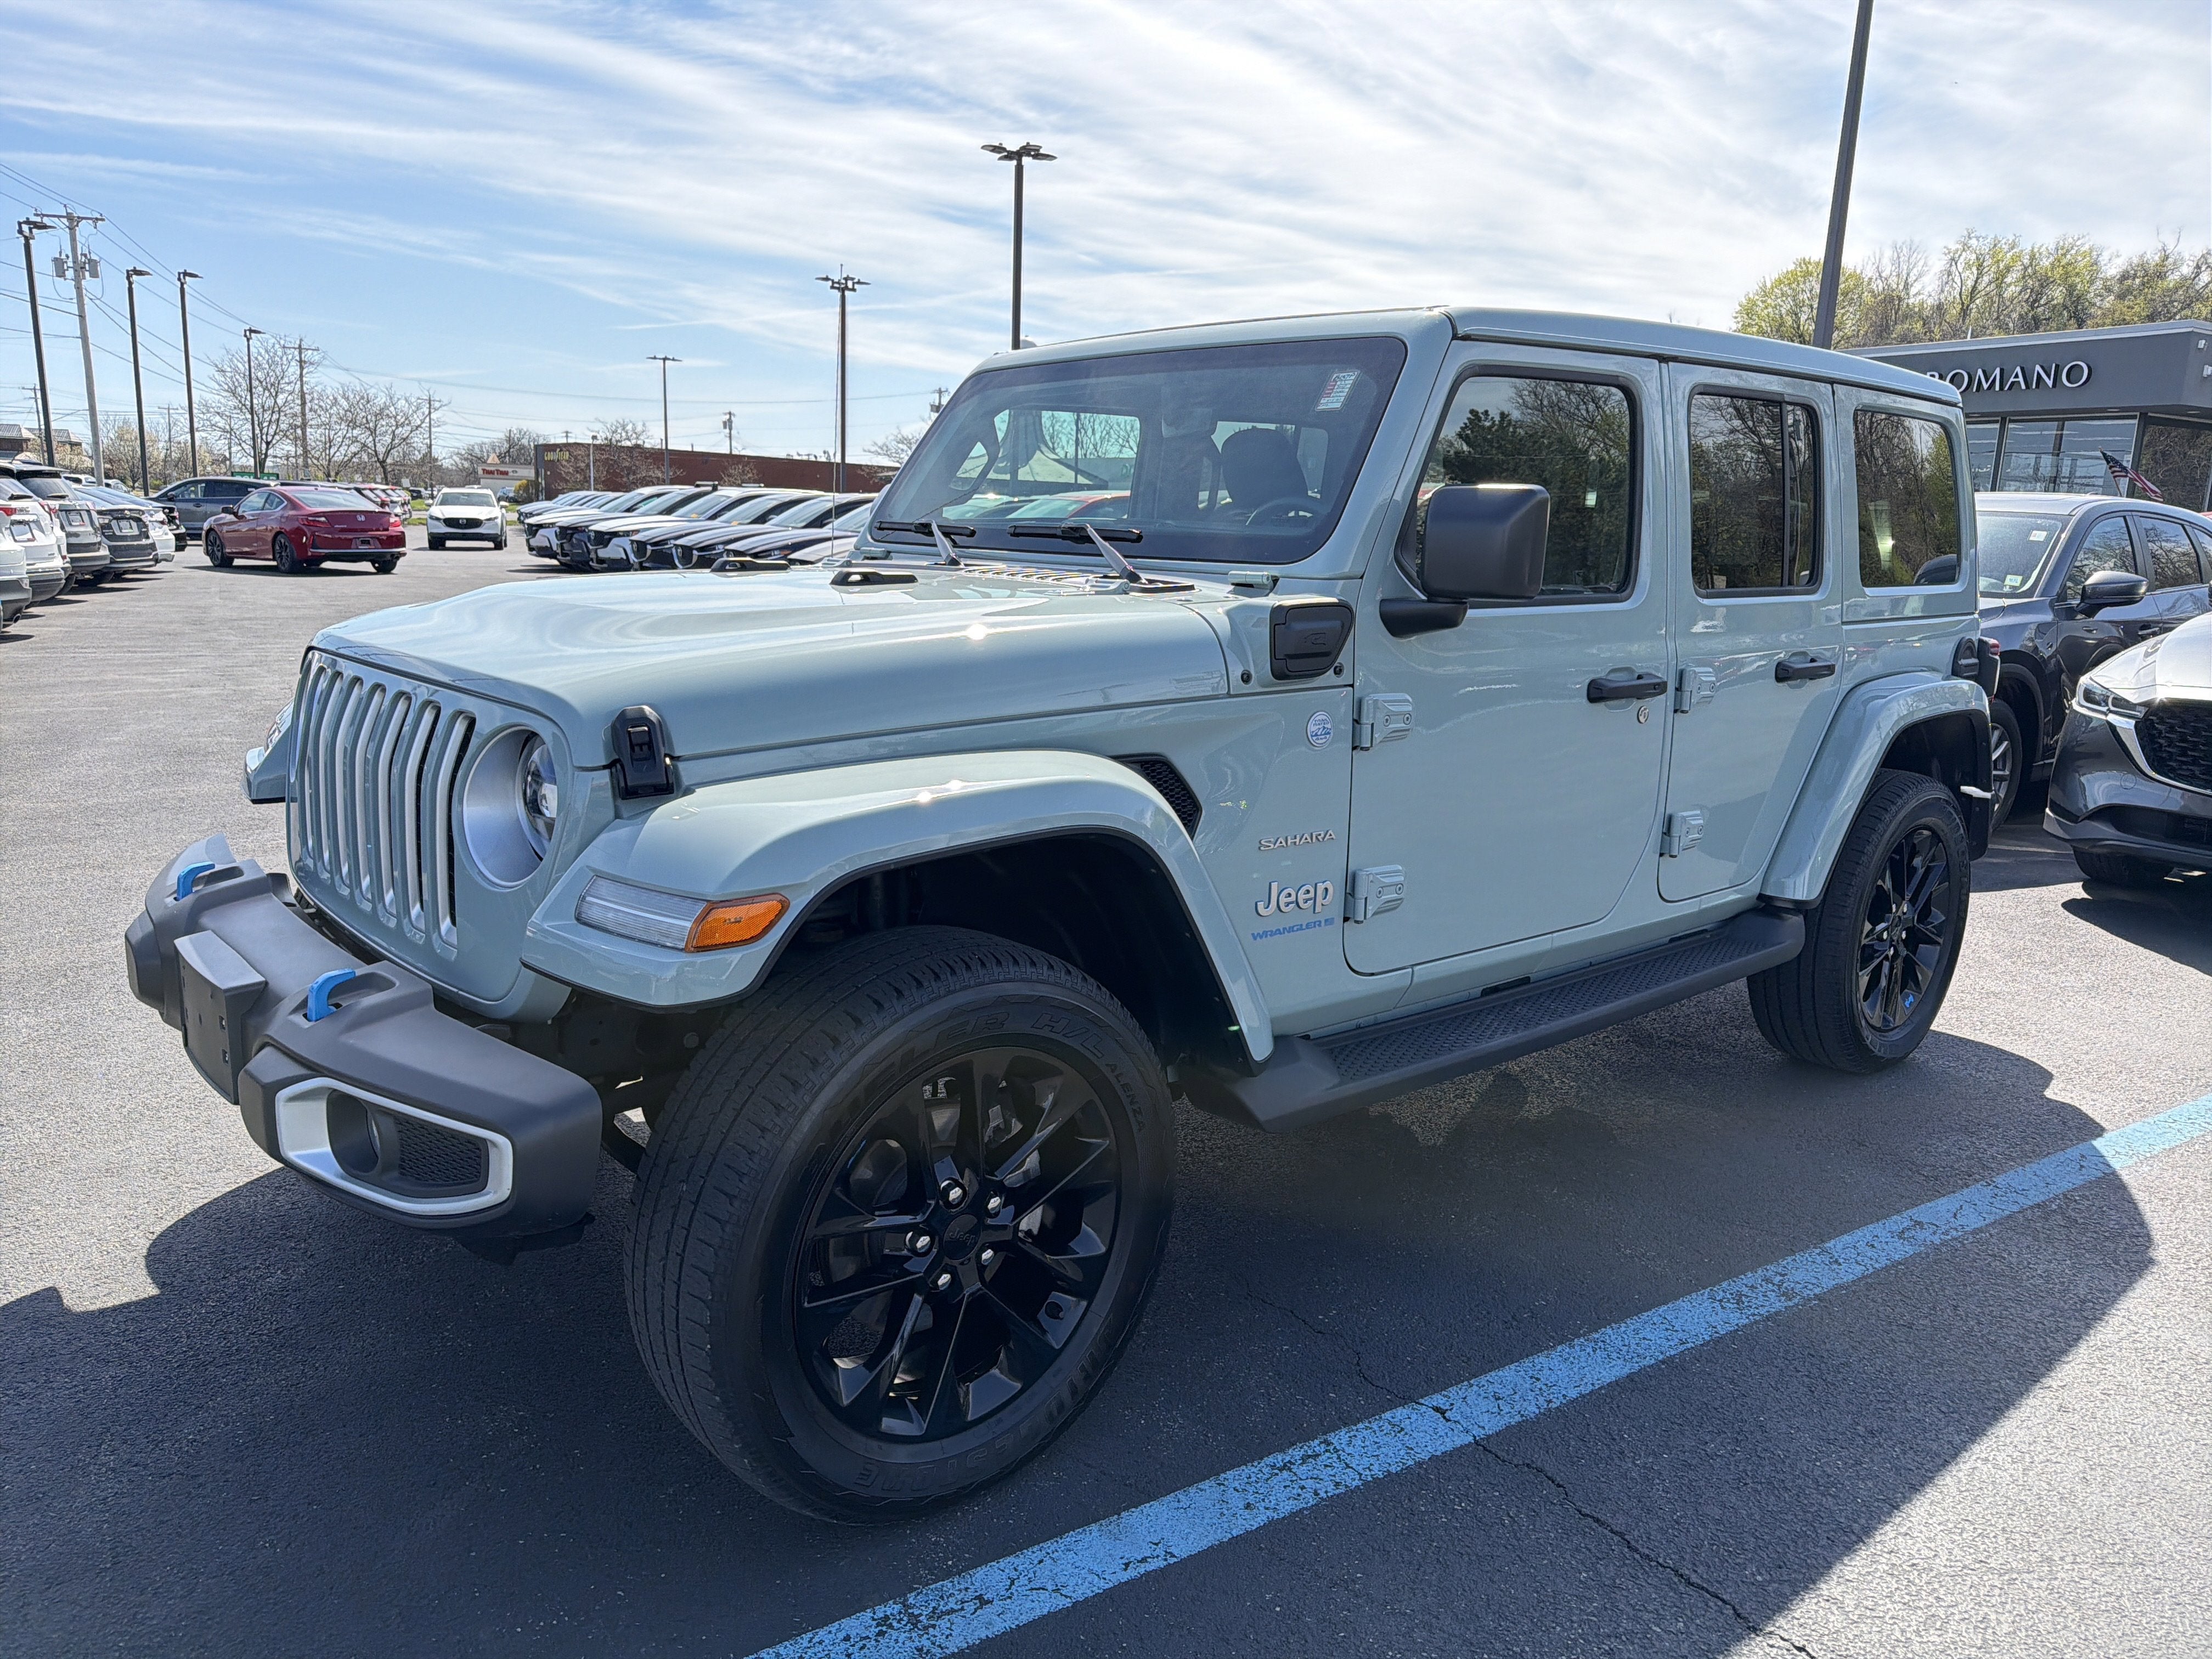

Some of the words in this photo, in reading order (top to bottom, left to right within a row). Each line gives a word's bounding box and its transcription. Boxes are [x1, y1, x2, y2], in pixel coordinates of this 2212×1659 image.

[1259, 830, 1336, 850] SAHARA
[1255, 880, 1334, 917] Jeep
[1251, 920, 1322, 941] WRANGLER
[949, 1227, 976, 1246] Jeep
